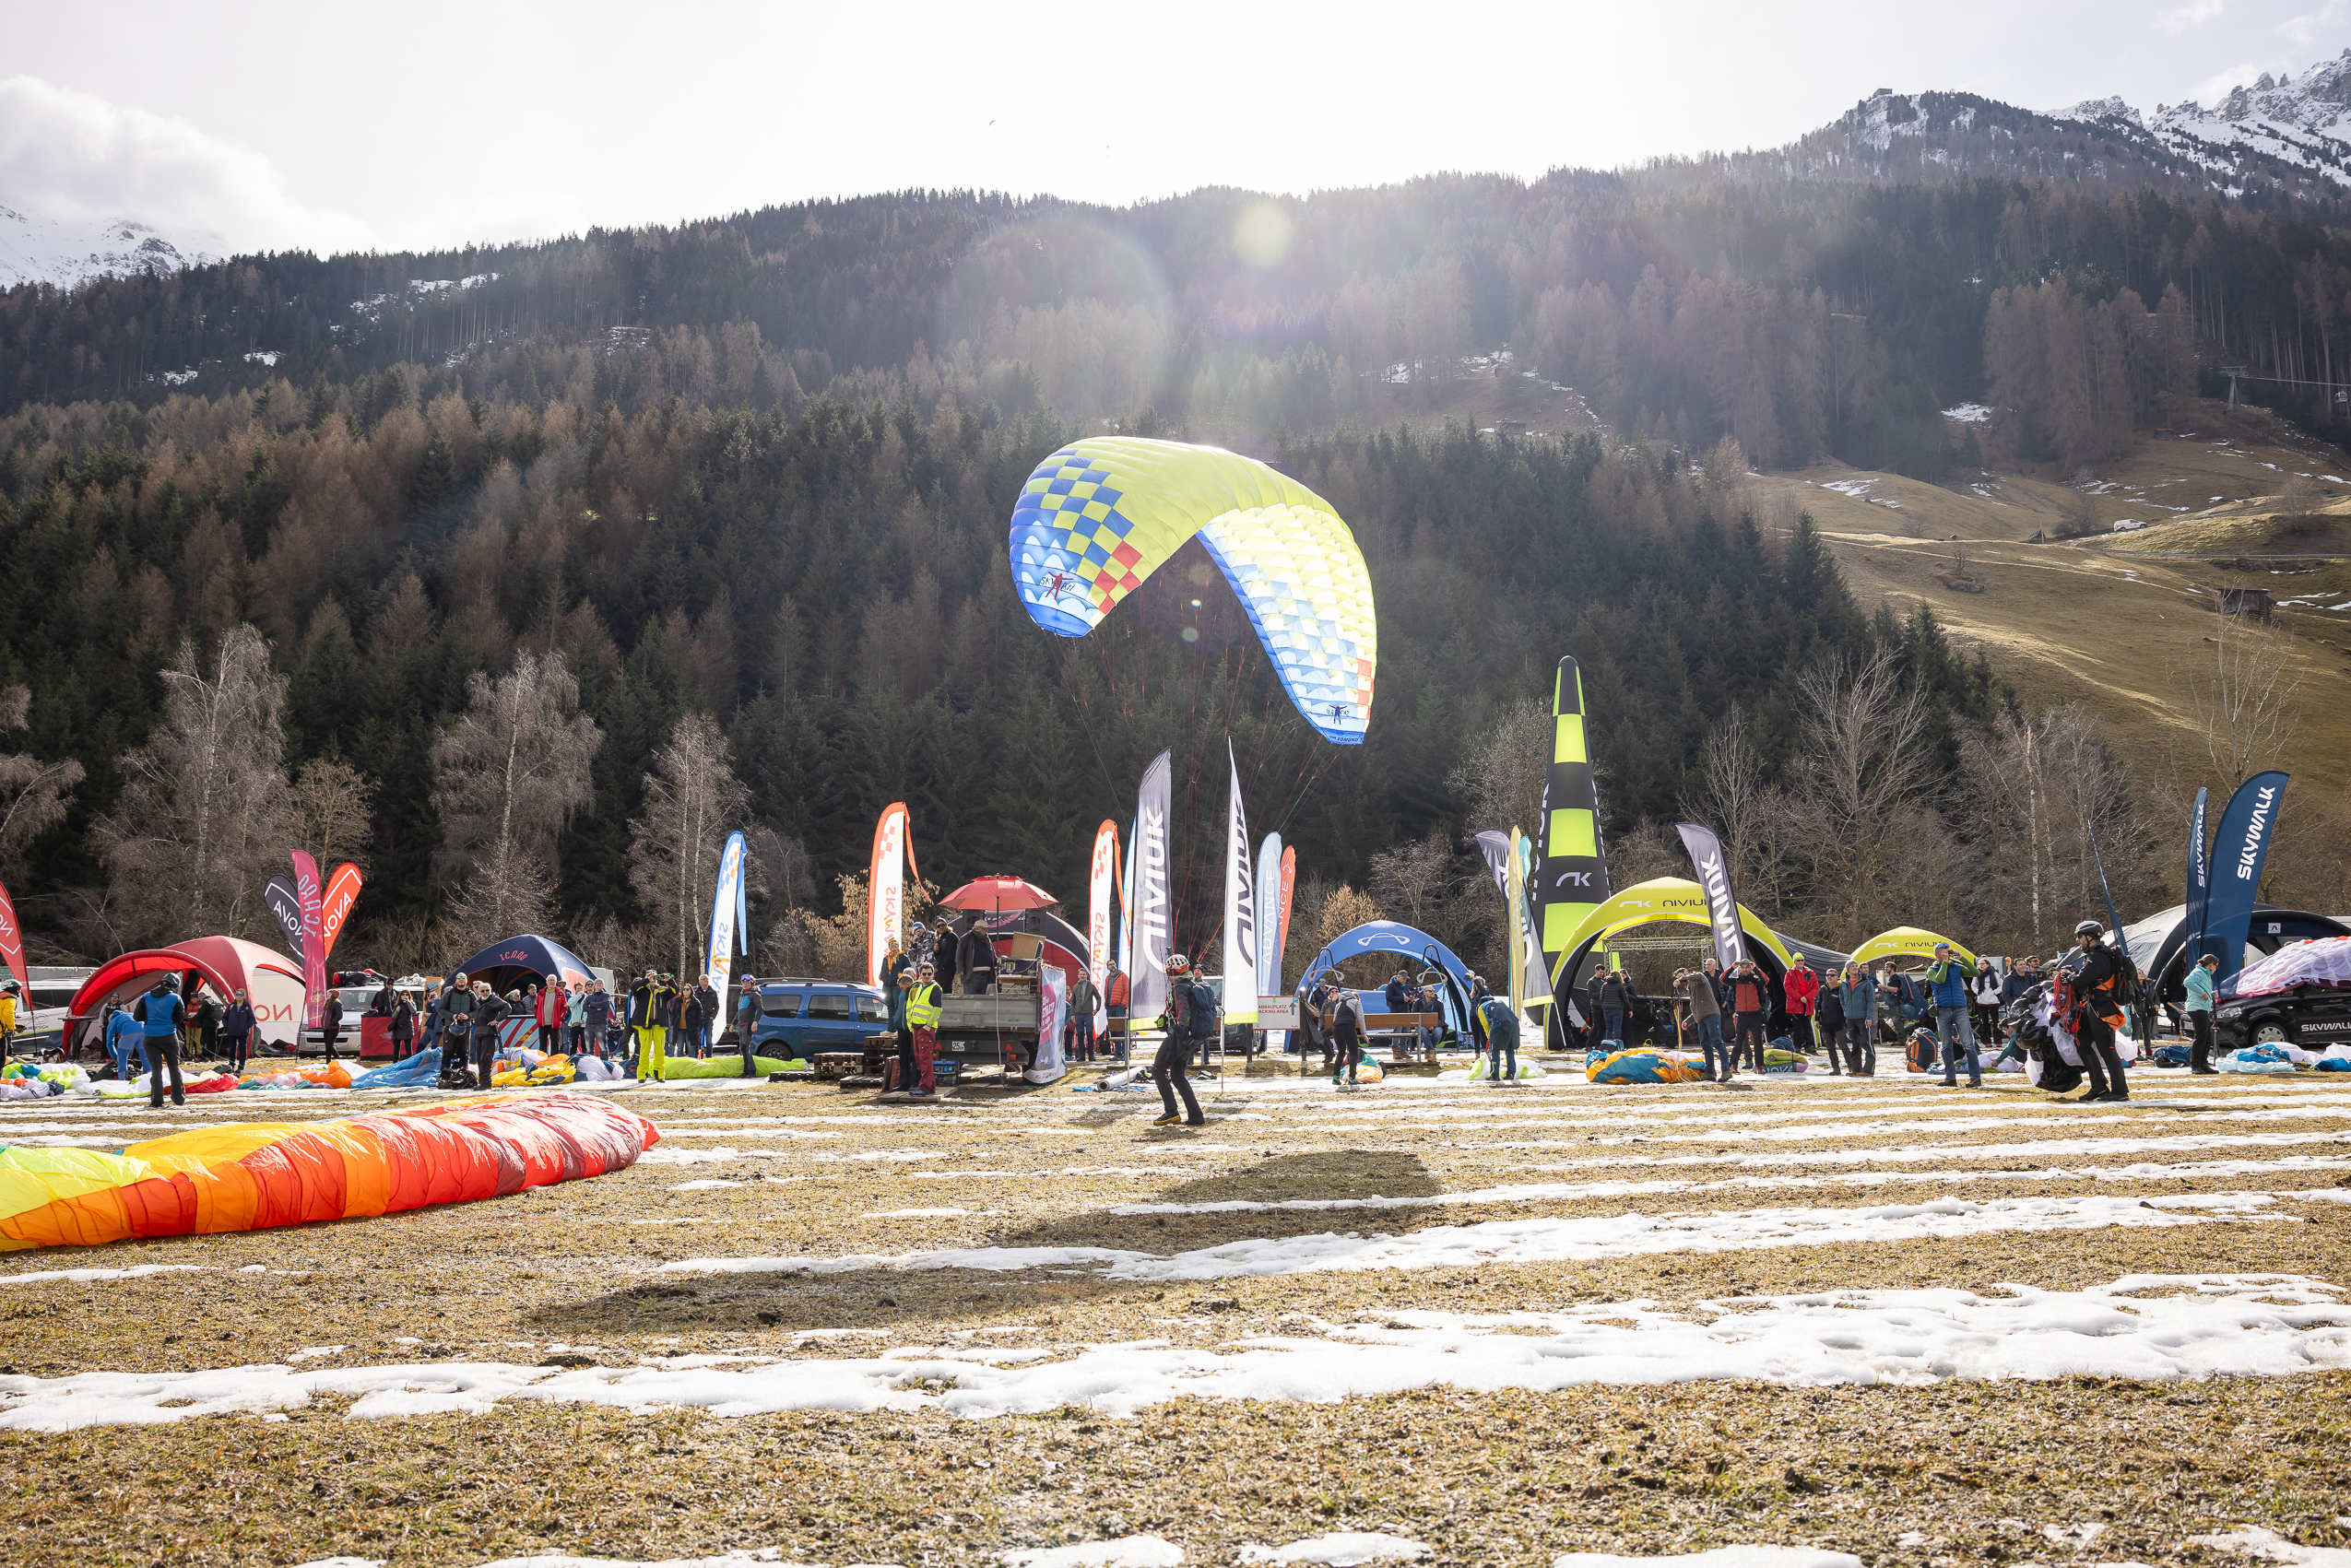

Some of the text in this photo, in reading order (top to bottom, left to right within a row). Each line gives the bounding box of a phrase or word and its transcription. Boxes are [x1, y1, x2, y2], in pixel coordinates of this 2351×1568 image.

[2197, 803, 2205, 888] SKYWALK
[2237, 786, 2275, 880] SKYWALK
[1142, 807, 1167, 973] NIVIUK
[1262, 869, 1275, 964] ADVANCE
[1662, 899, 1707, 907] NIVIU
[499, 949, 528, 961] ICARO
